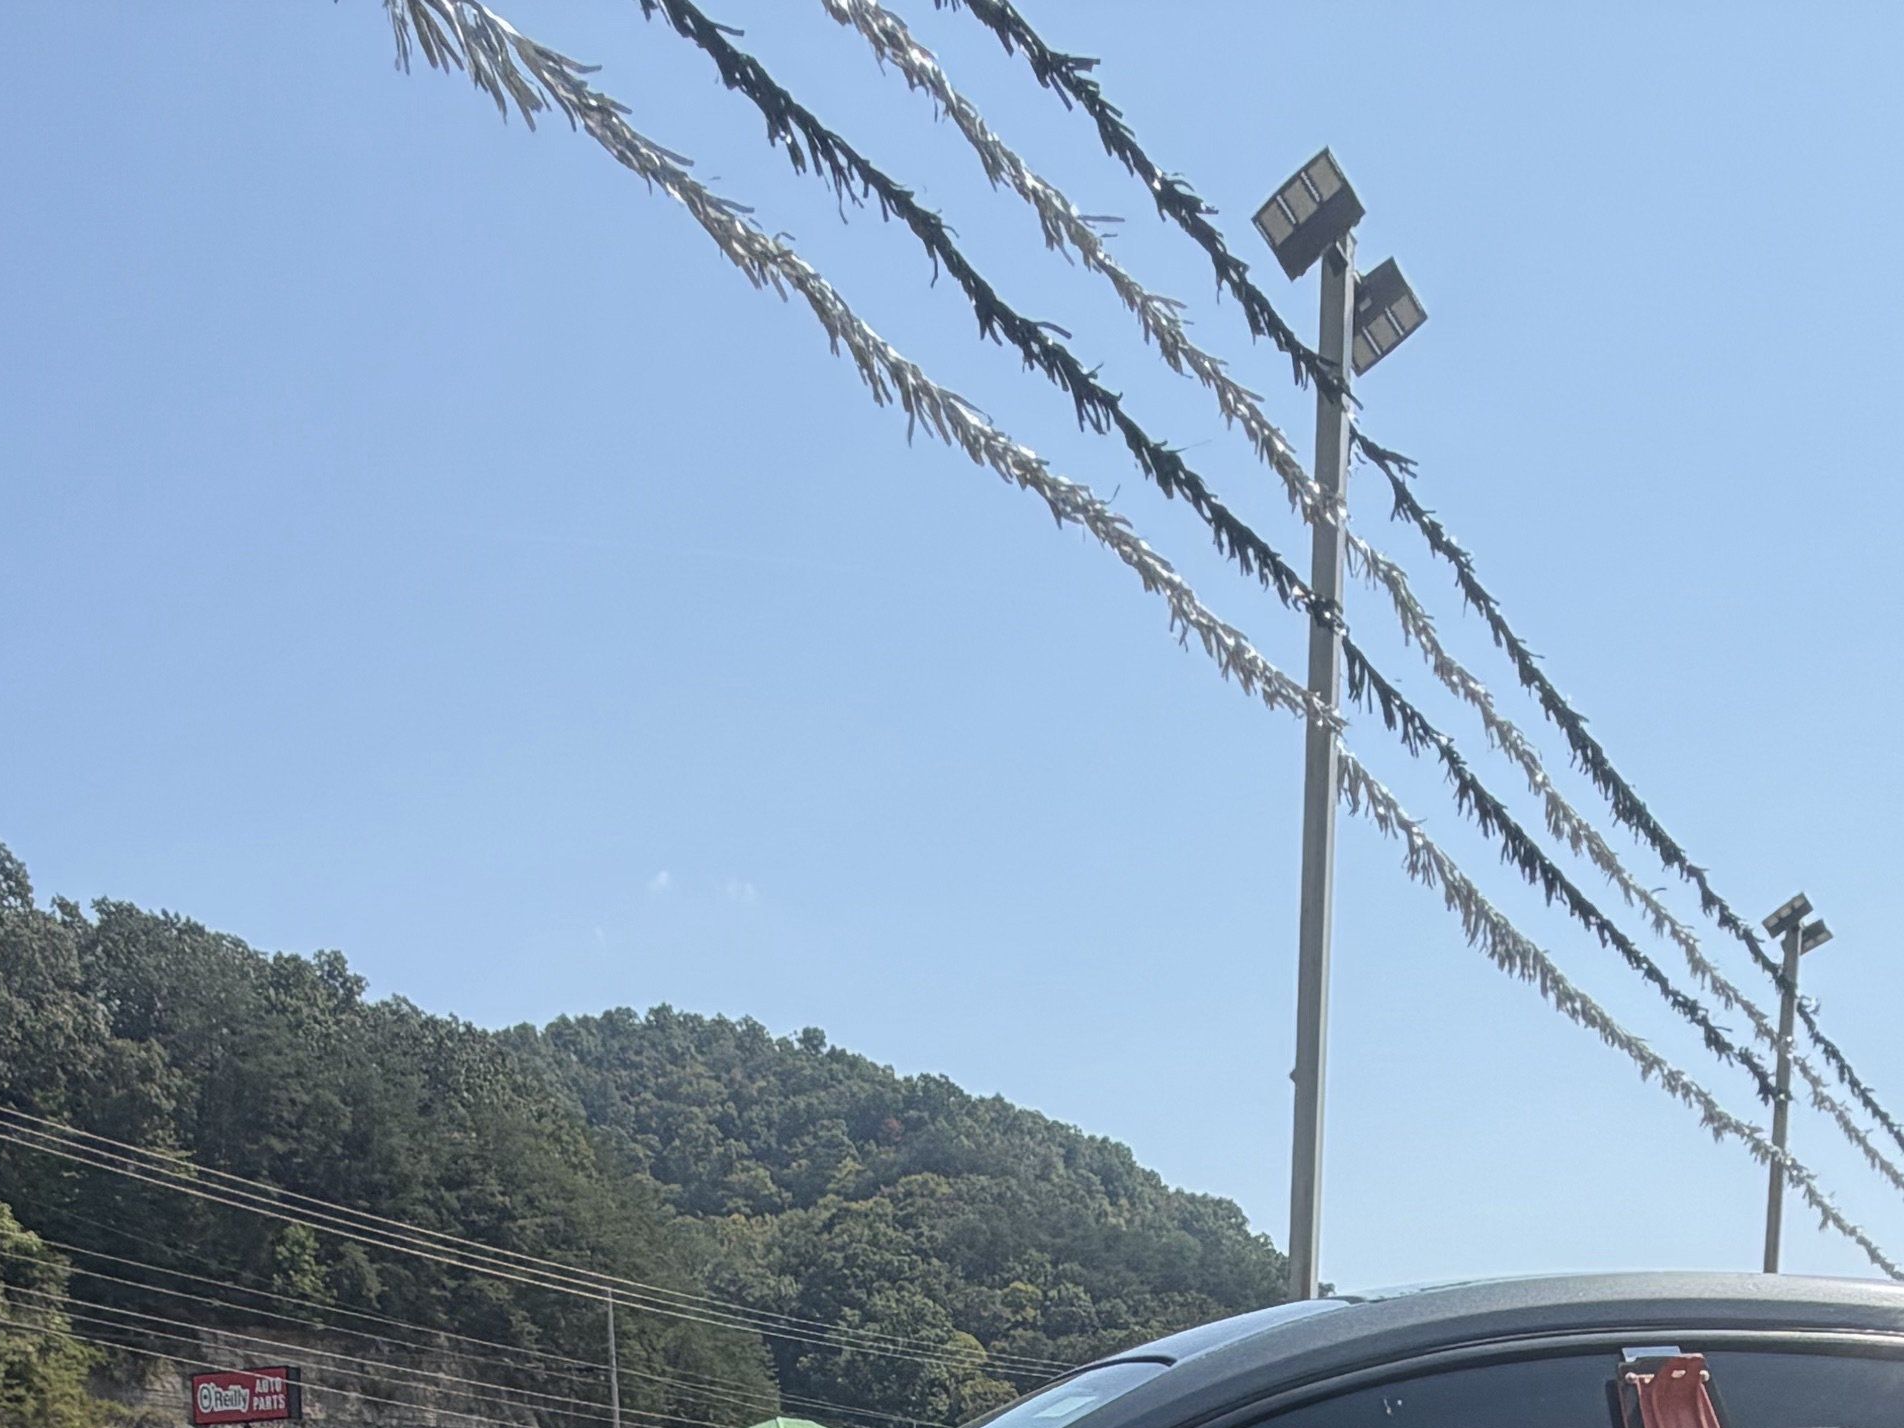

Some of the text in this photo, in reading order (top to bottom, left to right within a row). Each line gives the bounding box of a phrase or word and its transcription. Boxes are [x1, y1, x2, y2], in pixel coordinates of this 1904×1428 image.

[255, 1377, 282, 1394] AUTO
[197, 1382, 250, 1414] O'Reilly
[253, 1394, 286, 1412] PARTS
